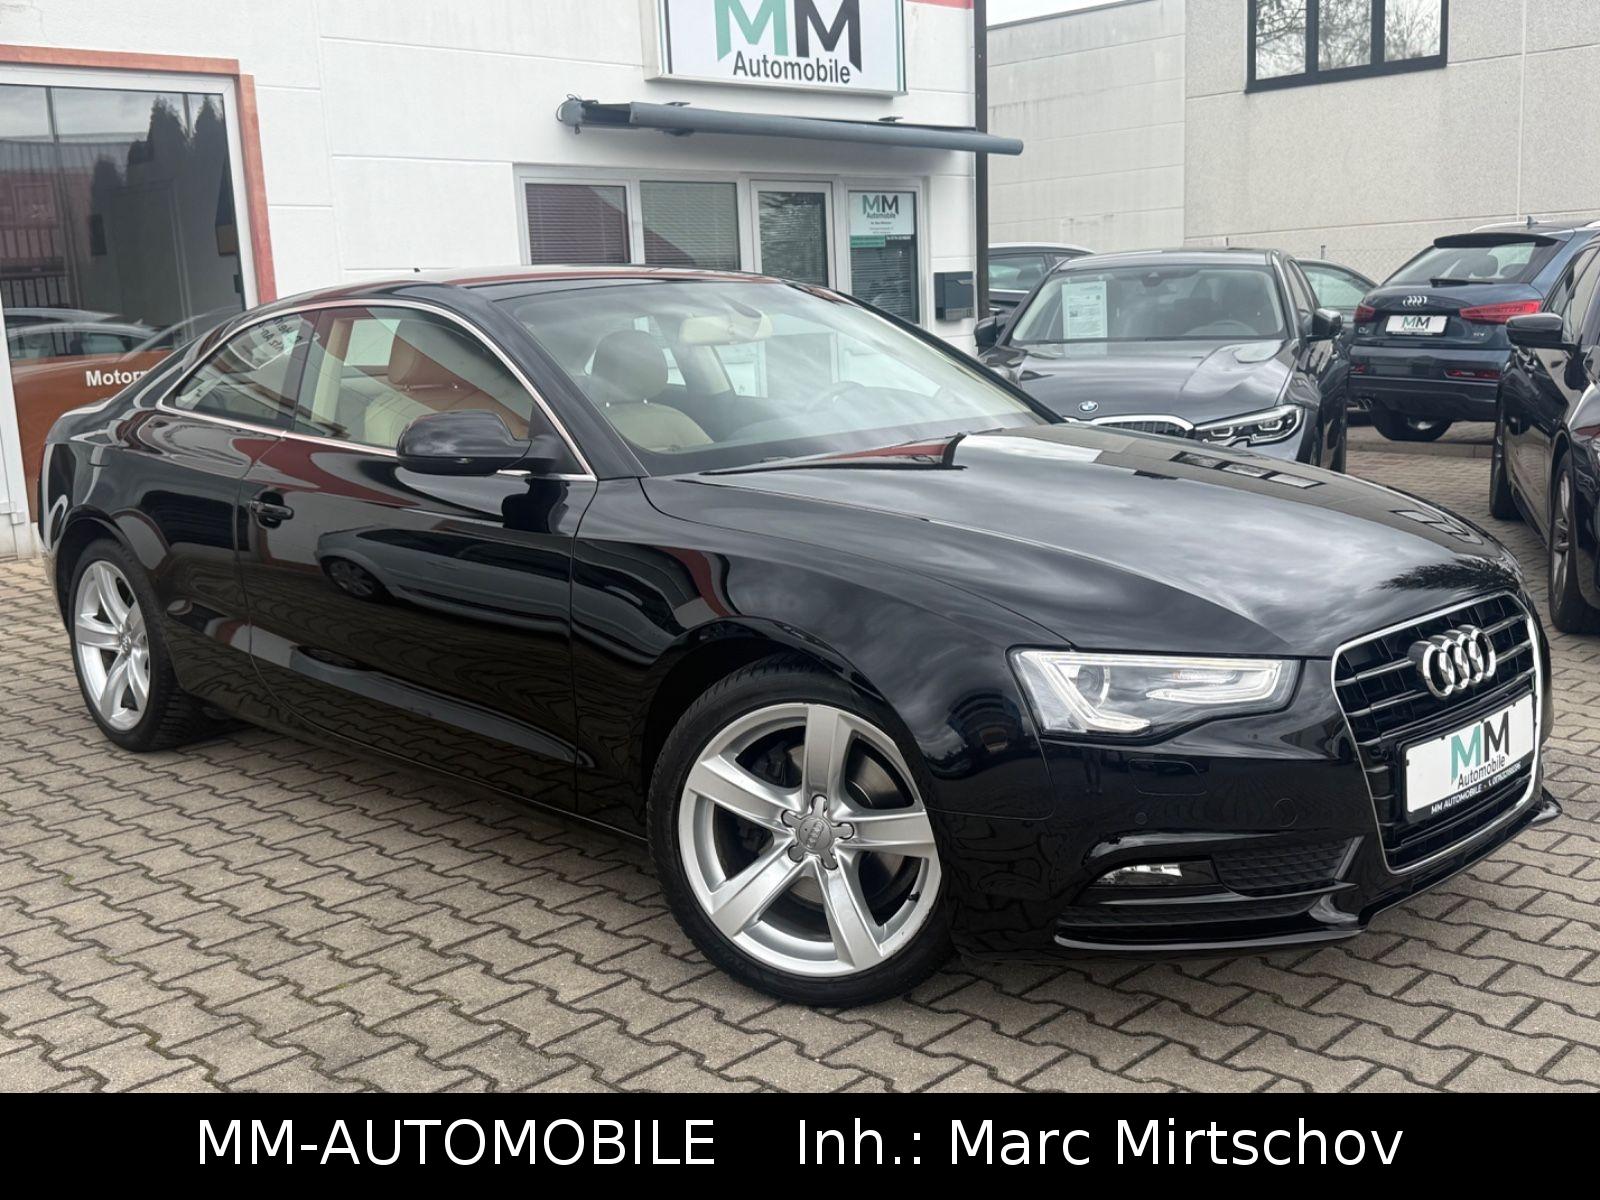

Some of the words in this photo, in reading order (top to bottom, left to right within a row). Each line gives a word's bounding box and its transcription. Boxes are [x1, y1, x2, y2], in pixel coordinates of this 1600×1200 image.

[714, 0, 862, 73] MM
[733, 51, 851, 84] Automobile
[862, 194, 899, 214] MM
[1402, 316, 1431, 329] MM
[1451, 711, 1510, 785] MM
[1457, 755, 1506, 789] Automobile
[1431, 801, 1443, 814] MM
[1443, 783, 1483, 809] AUTOMOBILE
